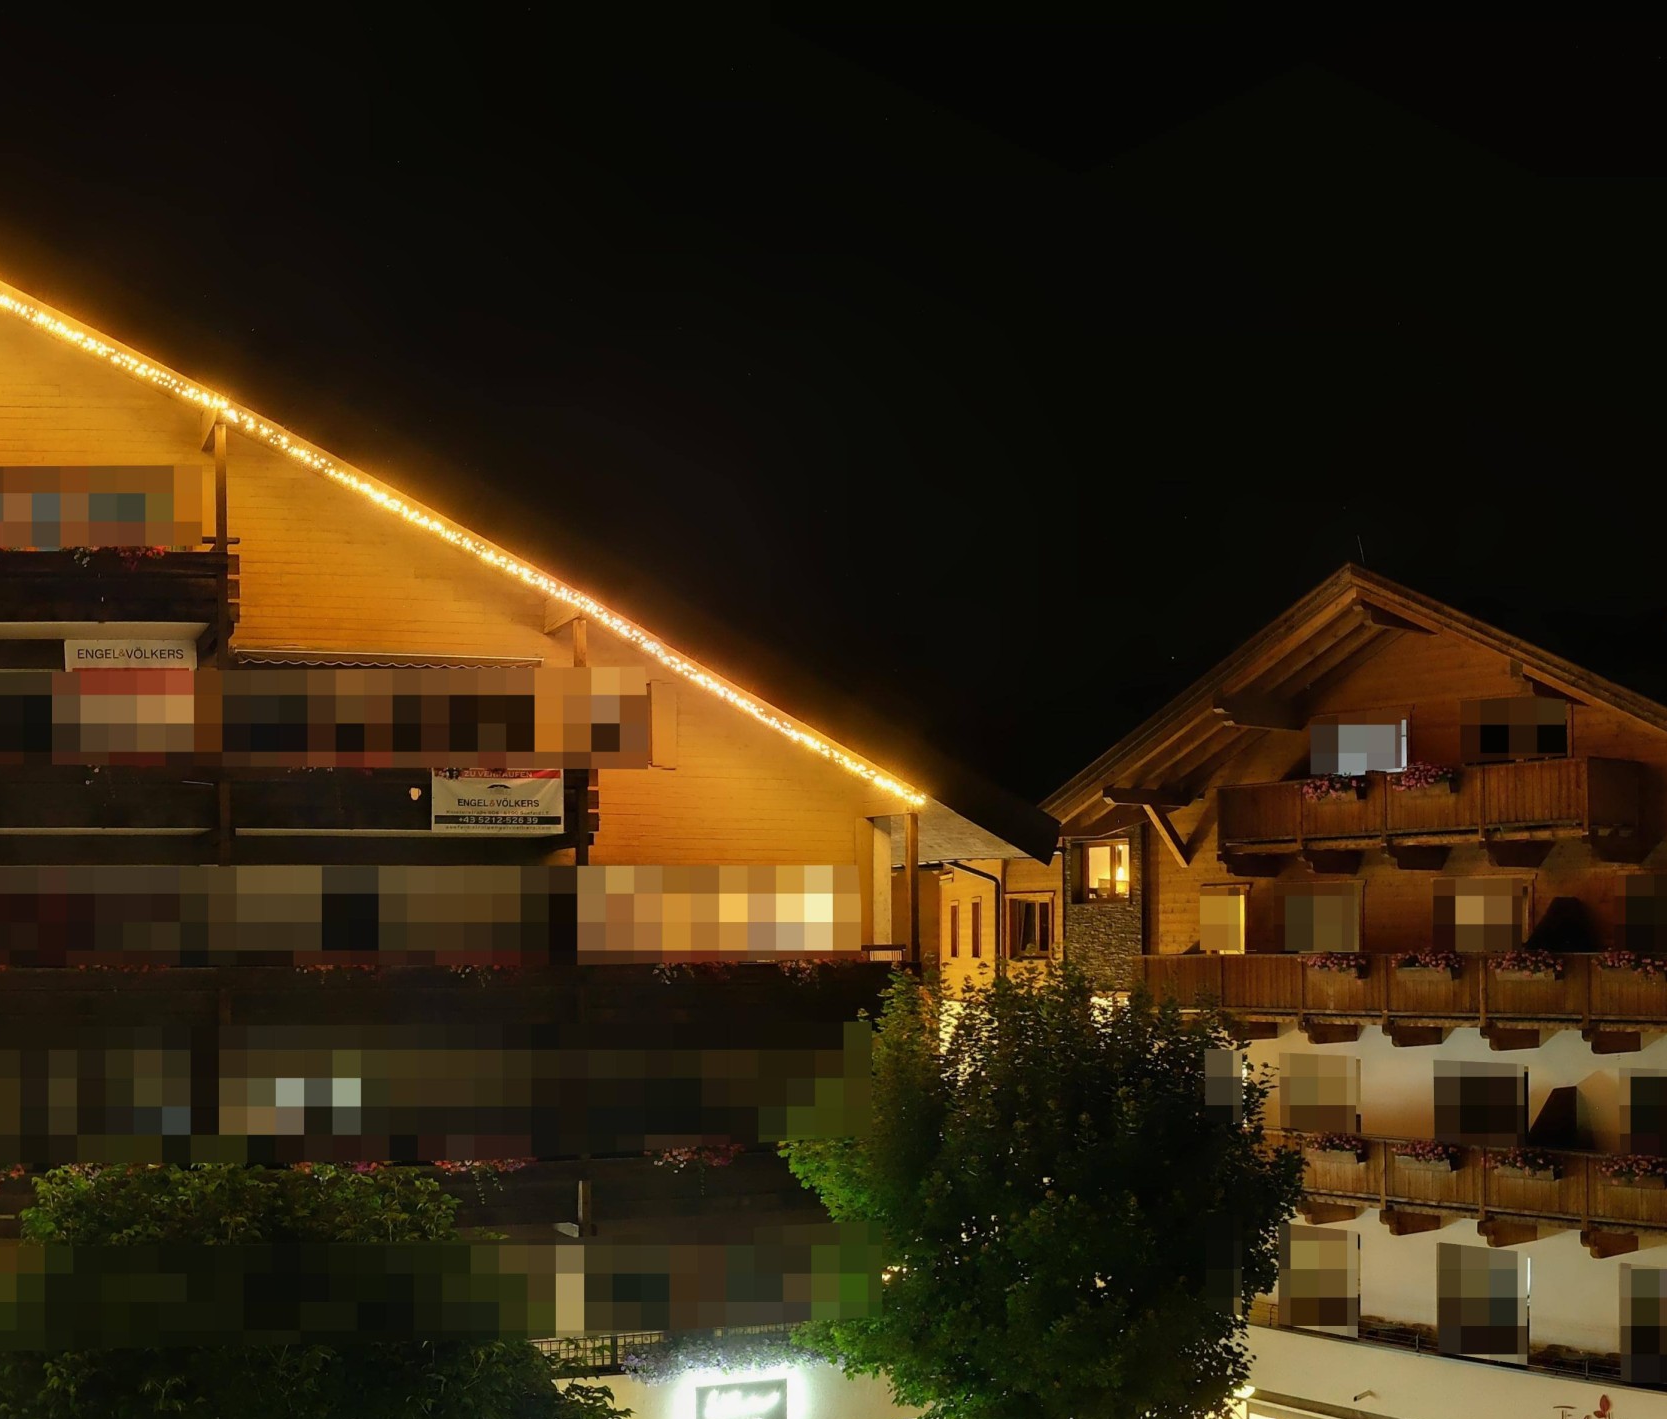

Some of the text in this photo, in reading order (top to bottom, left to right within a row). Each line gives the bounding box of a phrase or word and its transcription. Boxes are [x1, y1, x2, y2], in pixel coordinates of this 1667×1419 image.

[479, 770, 533, 778] VERAUFEN
[459, 816, 475, 824] +43
[478, 816, 524, 824] 5212-526
